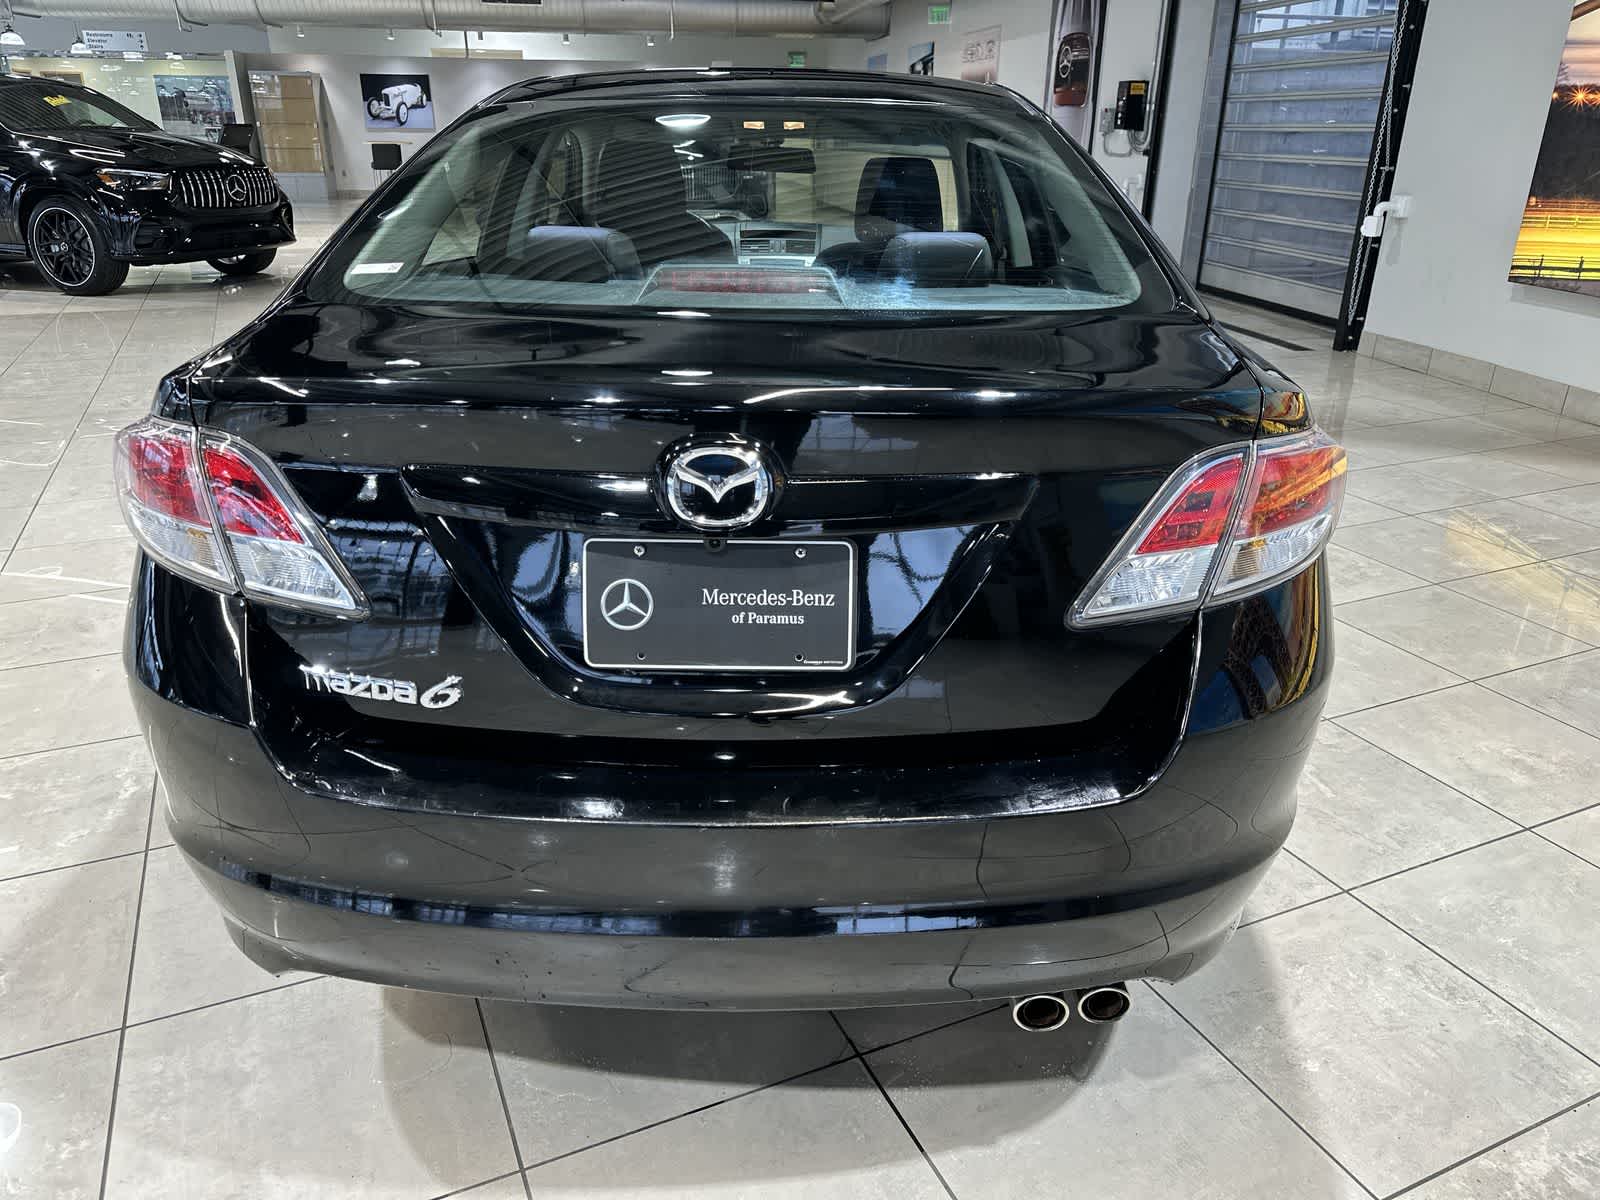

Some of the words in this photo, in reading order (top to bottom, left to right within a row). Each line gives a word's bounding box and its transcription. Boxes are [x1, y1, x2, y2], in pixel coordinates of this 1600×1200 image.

[702, 588, 836, 607] Mercedes-Benz
[731, 611, 746, 624] of
[748, 612, 805, 625] Paramus
[419, 674, 463, 709] 6
